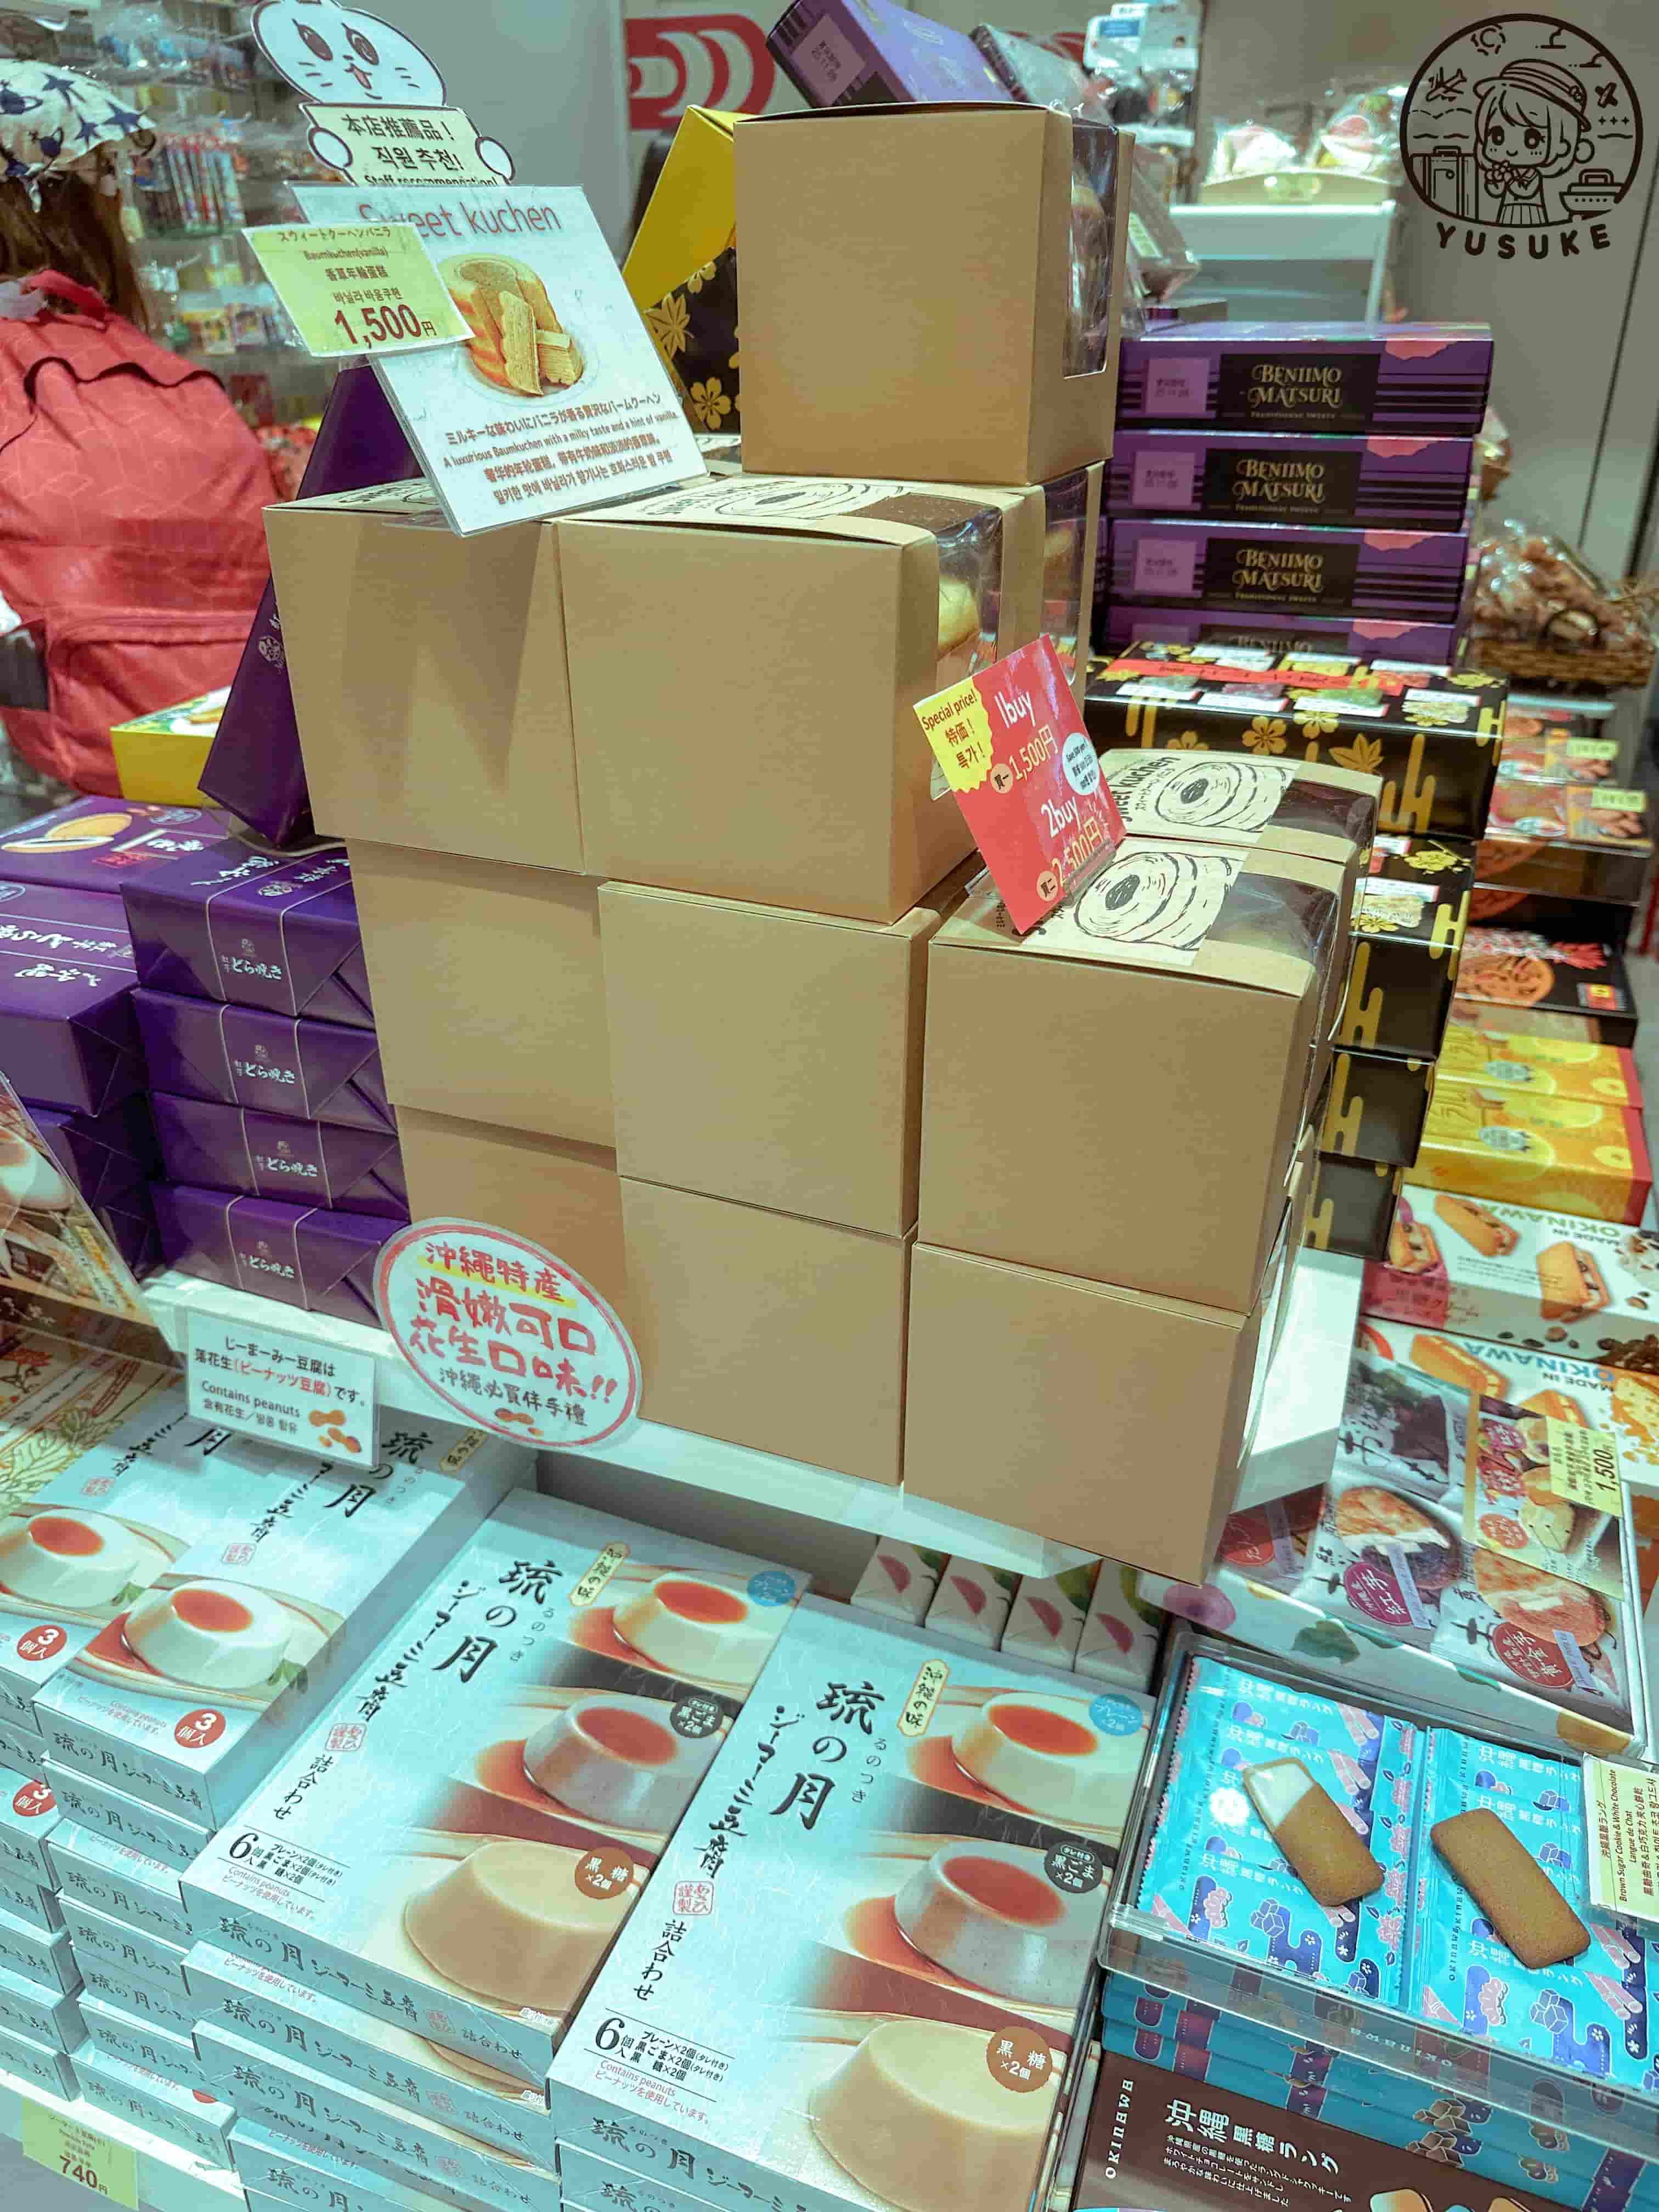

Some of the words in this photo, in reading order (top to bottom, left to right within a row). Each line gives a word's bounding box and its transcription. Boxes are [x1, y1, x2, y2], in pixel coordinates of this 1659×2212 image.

[371, 144, 419, 170] 직원
[460, 200, 562, 234] kuchen
[1251, 363, 1343, 385] BENIIMO
[1248, 385, 1343, 409] MATSURI
[443, 458, 452, 469] A
[452, 450, 493, 466] luxurious
[492, 438, 543, 458] Baumkuchen
[543, 433, 563, 448] with
[569, 426, 589, 442] milky
[590, 424, 611, 437] taste
[610, 420, 625, 432] and
[630, 416, 645, 429] hint
[645, 413, 654, 425] of
[1235, 458, 1324, 480] BENIIMO
[1233, 479, 1324, 504] MATSURI
[1235, 549, 1324, 571] BENIIMO
[1232, 570, 1324, 594] MATSURI
[922, 704, 953, 731] Special
[953, 687, 978, 715] price!
[1041, 795, 1081, 838] 2buy
[225, 1335, 335, 1376] じーまーみー豆腐は
[1463, 1341, 1615, 1381] OKINAWA
[201, 1380, 251, 1404] Contains
[254, 1397, 300, 1418] peanuts
[38, 1629, 59, 1645] 3
[432, 1560, 563, 1684] 琉の月
[194, 1712, 217, 1731] 3
[676, 1705, 715, 1727] 黒ごま
[177, 1725, 206, 1745] 個入
[54, 1732, 118, 1773] 琉の月
[769, 1680, 885, 1830] 琉の月
[851, 1737, 888, 1804] るのつき
[1609, 1769, 1618, 1802] Chocolate
[33, 1784, 52, 1800] 3
[274, 1754, 334, 1820] 詰合わせ
[1611, 1802, 1620, 1824] White
[1625, 1810, 1633, 1826] Chat
[229, 1832, 259, 1859] 6
[1614, 1831, 1623, 1854] Cookie
[1626, 1827, 1634, 1836] de
[1616, 1856, 1626, 1876] Sugar
[1627, 1838, 1637, 1863] Langue
[228, 1866, 261, 1888] Contains
[260, 1879, 290, 1897] peanuts
[1052, 1854, 1094, 1879] 黒ごま
[1617, 1878, 1627, 1902] Brown
[219, 1916, 303, 1971] 琉の月
[633, 1920, 687, 2001] 詰合わせ
[223, 1996, 308, 2052] 琉の月
[595, 2017, 625, 2050] 6
[614, 2035, 635, 2059] 個入
[996, 2039, 1046, 2070] 黒糖
[233, 2064, 317, 2118] 琉の月
[599, 2059, 639, 2084] Contains
[640, 2075, 676, 2097] peanuts
[595, 2069, 710, 2125] ピーナッツを使用しています。
[592, 2118, 696, 2180] 琉の月
[1165, 2098, 1339, 2176] 沖縄黒糖ラング
